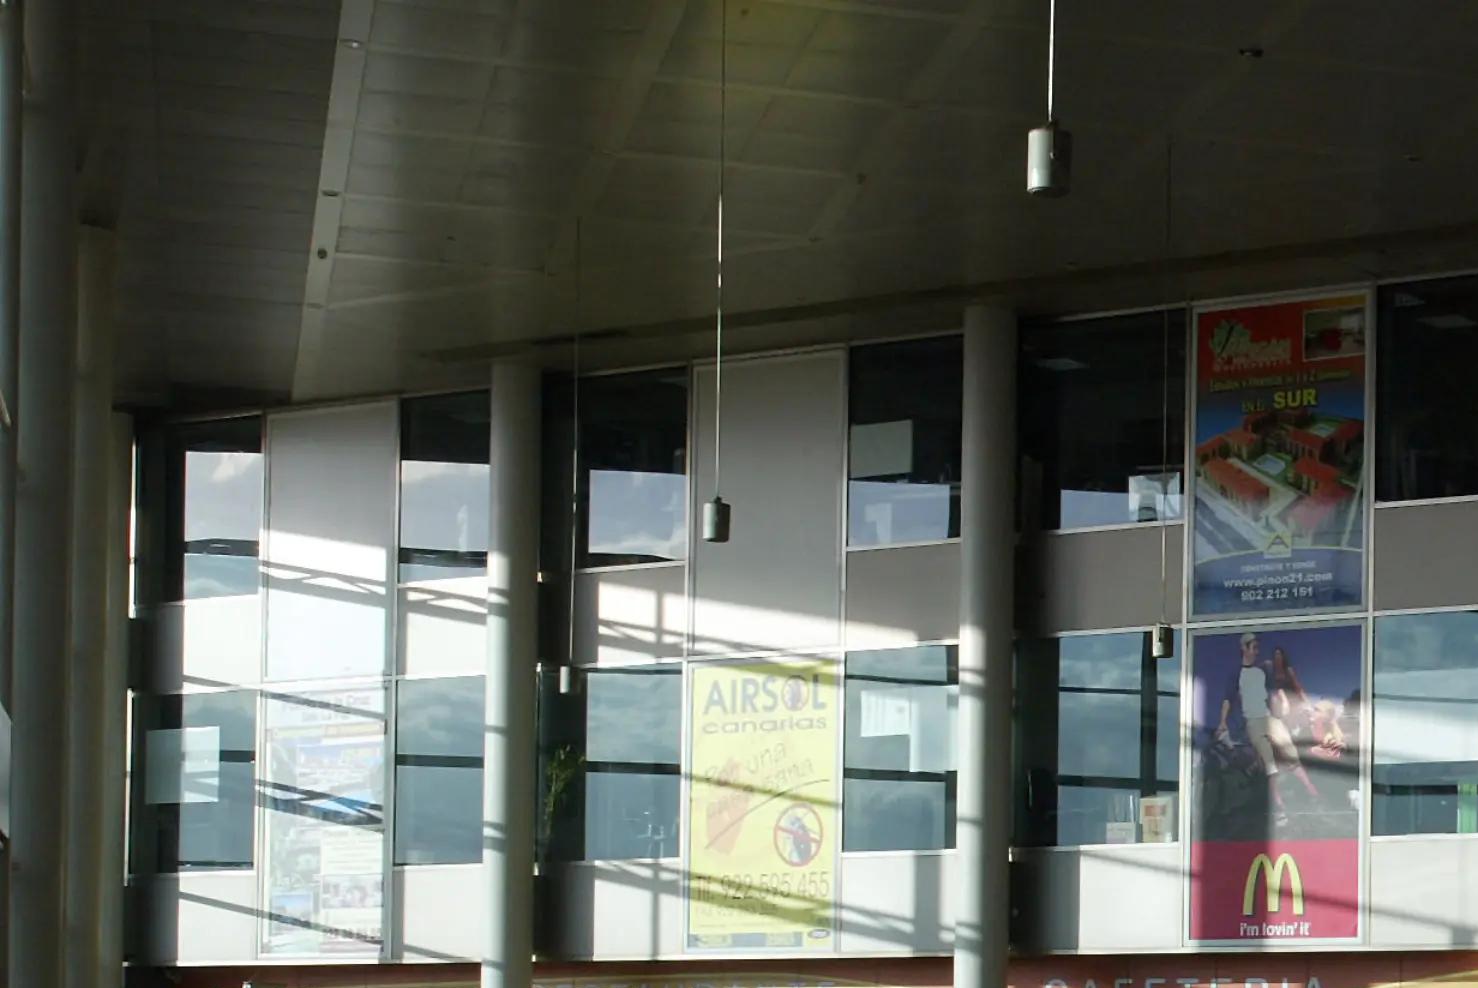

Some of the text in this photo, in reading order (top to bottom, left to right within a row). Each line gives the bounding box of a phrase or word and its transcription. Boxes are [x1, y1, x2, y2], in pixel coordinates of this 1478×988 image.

[1273, 388, 1318, 410] SUR
[1266, 588, 1289, 600] 212
[701, 716, 828, 735] canarias
[797, 871, 830, 897] 455
[1239, 922, 1260, 937] i'm
[1262, 921, 1298, 937] lovin'
